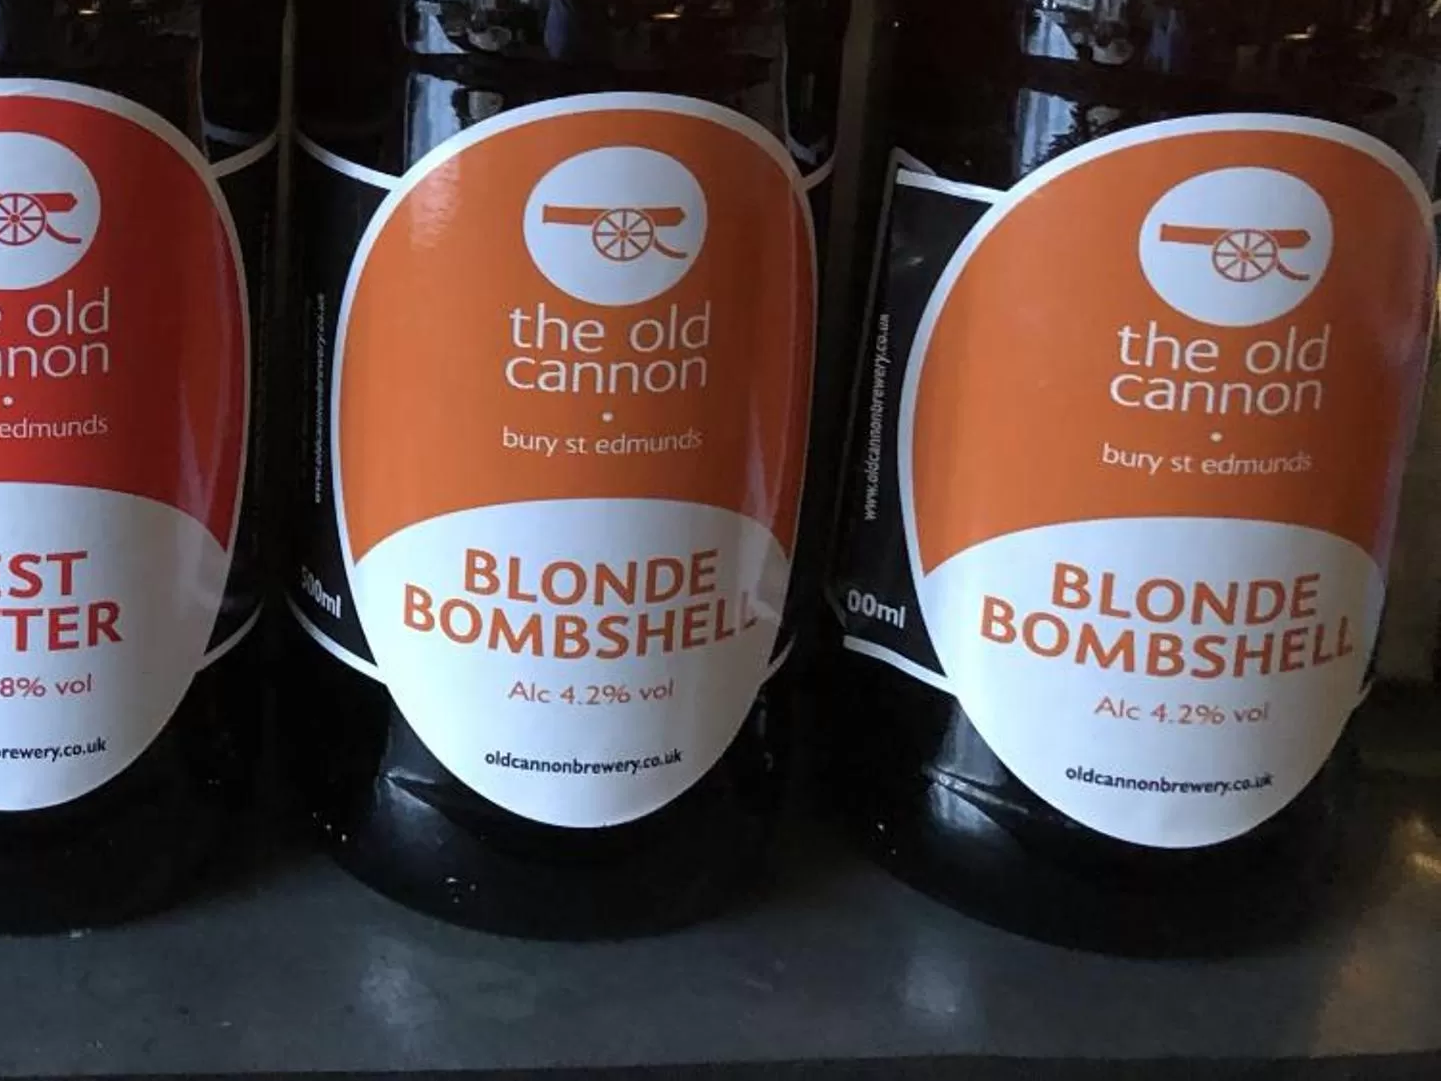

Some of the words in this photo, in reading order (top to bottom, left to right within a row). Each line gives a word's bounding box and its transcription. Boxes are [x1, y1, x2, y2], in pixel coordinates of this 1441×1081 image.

[27, 286, 111, 337] old
[509, 302, 605, 353] the
[630, 300, 711, 350] old
[1117, 321, 1219, 373] the
[1245, 323, 1332, 375] old
[505, 355, 707, 395] cannon
[1109, 373, 1323, 416] cannon
[502, 427, 559, 457] bury
[566, 435, 587, 455] st
[595, 427, 703, 456] edmunds
[1101, 442, 1163, 477] bury
[1170, 452, 1193, 475] st
[1200, 450, 1313, 476] edmunds
[463, 547, 719, 607] BLONDE
[1052, 561, 1321, 625] BLONDE
[402, 582, 758, 661] BOMBSHELL
[979, 594, 1354, 679] BOMBSHELL
[55, 674, 93, 695] vol
[508, 680, 551, 704] Alc
[559, 684, 632, 706] 4.2%
[639, 678, 675, 700] vol
[1093, 695, 1141, 723] Alc
[1150, 702, 1226, 725] 4.2%
[1232, 701, 1271, 723] vol
[485, 748, 682, 776] oldcannonbrewery.co.uk
